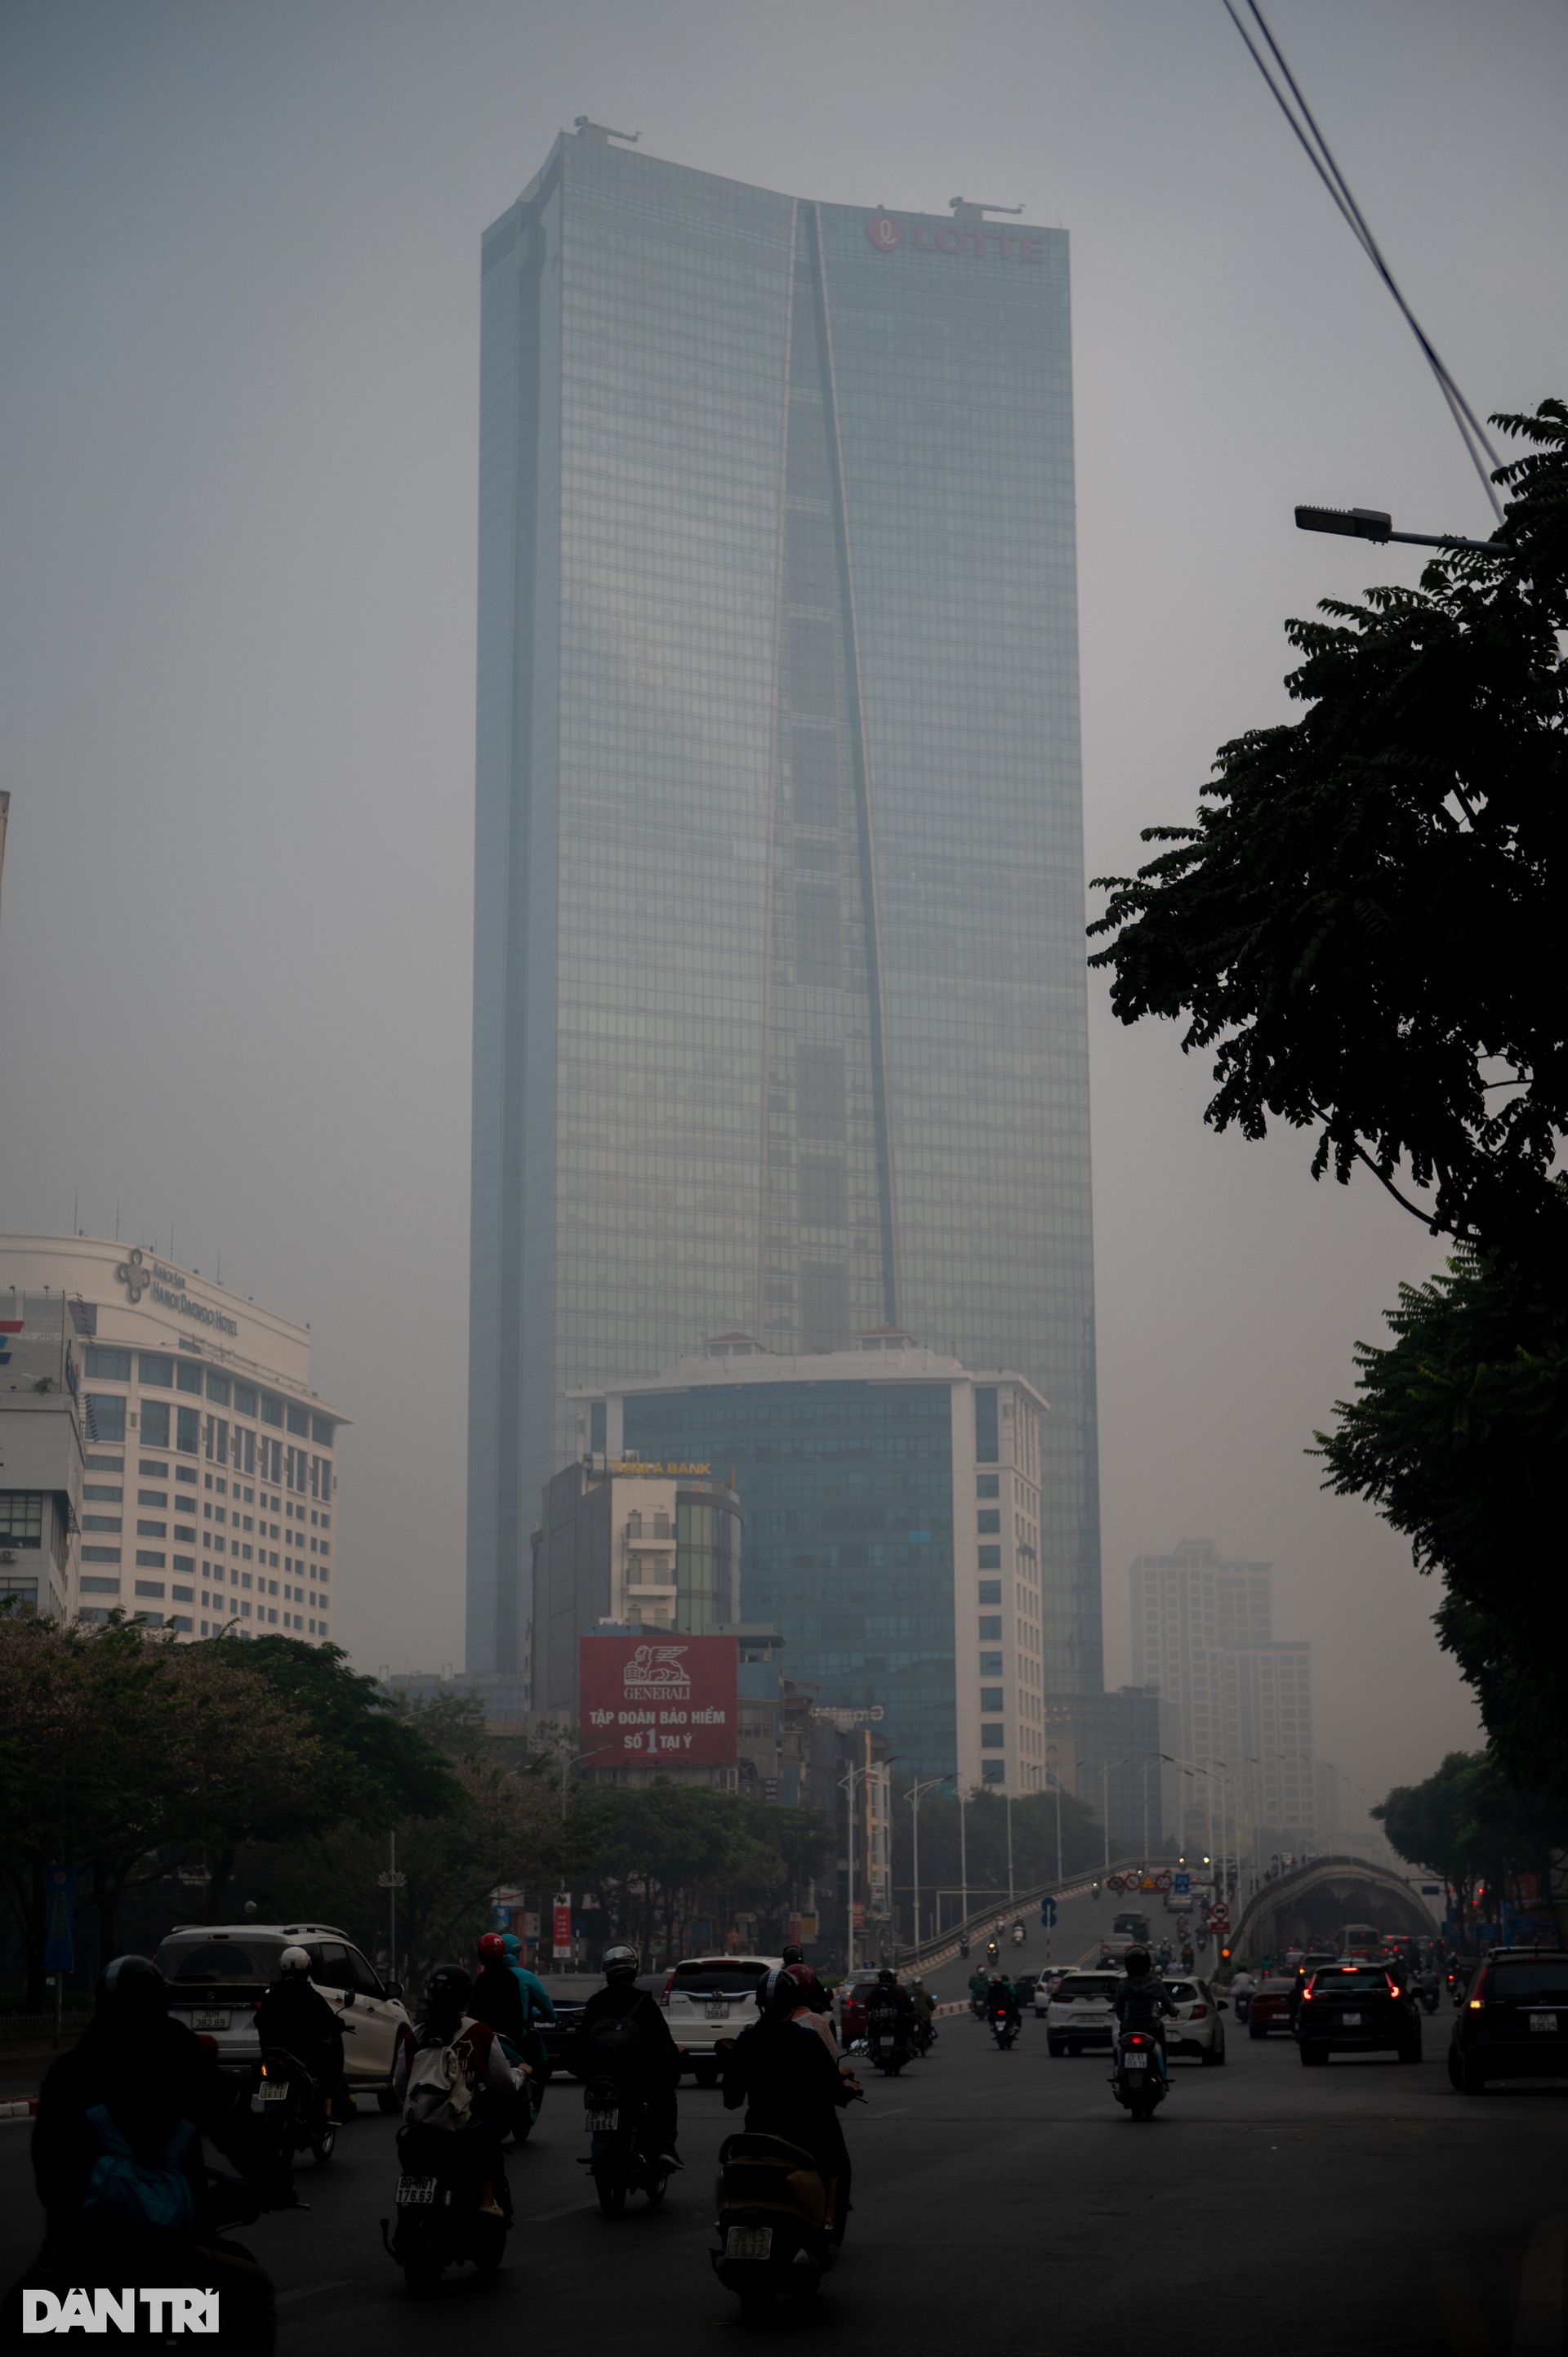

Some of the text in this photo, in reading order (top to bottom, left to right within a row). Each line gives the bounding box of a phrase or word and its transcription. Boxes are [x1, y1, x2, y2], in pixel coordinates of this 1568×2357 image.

[915, 223, 1045, 263] LOTTE
[180, 1294, 214, 1325] DAEWOO
[215, 1309, 238, 1337] HOTEL
[653, 1461, 664, 1474] A
[667, 1462, 711, 1475] BANK
[624, 1687, 691, 1700] GENERALI
[590, 1706, 725, 1727] TẬP ĐOÀN BẢO HIỂM
[624, 1728, 693, 1753] SỐ 1 TẠI Ý
[196, 2018, 225, 2027] 382.89
[399, 2190, 432, 2203] 176.63
